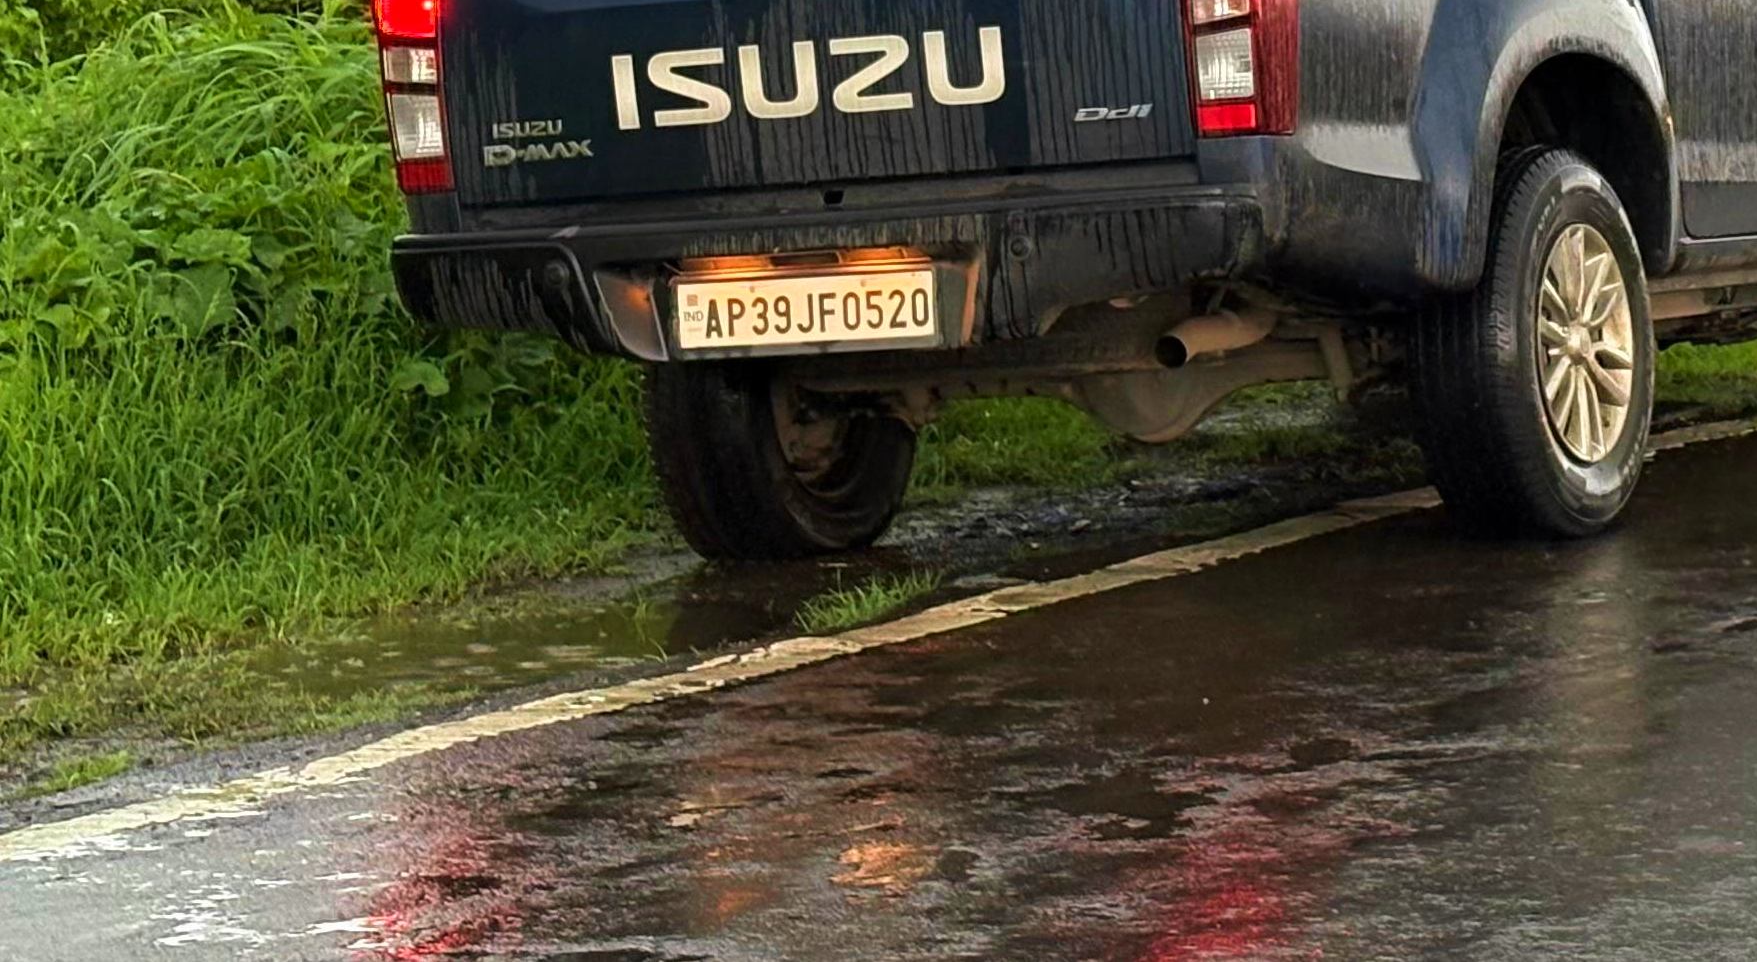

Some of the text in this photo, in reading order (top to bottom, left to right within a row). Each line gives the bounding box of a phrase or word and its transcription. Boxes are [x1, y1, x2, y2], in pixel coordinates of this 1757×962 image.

[611, 26, 1006, 131] ISUZU
[492, 119, 562, 139] ISUZU
[483, 139, 594, 167] D-MAX
[683, 310, 704, 322] IND
[705, 287, 930, 339] AP39JF0520
